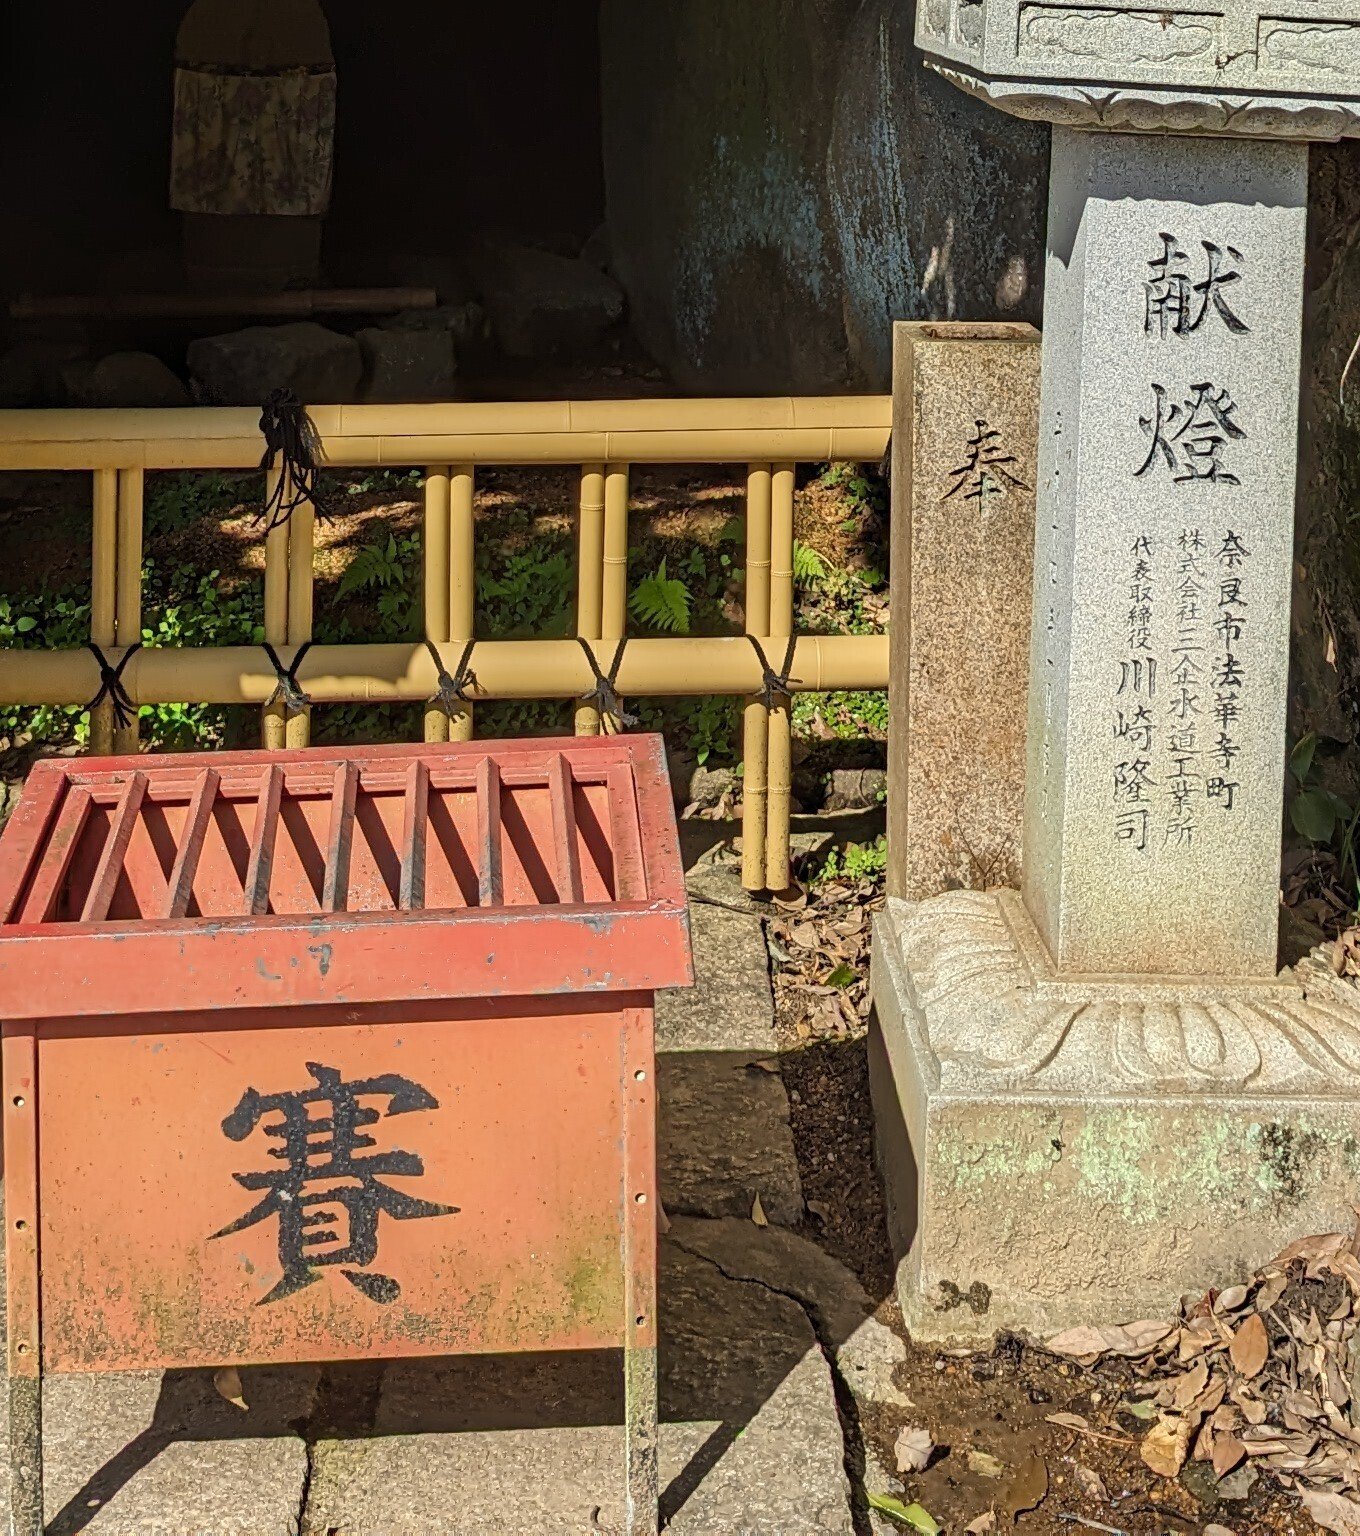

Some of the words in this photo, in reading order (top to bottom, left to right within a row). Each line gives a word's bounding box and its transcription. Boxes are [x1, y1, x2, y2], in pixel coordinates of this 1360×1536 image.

[941, 419, 1033, 517] 奉
[1132, 232, 1252, 487] 献燈
[1206, 529, 1251, 811] 奈良市法華寺町
[206, 1061, 462, 1307] 賽
